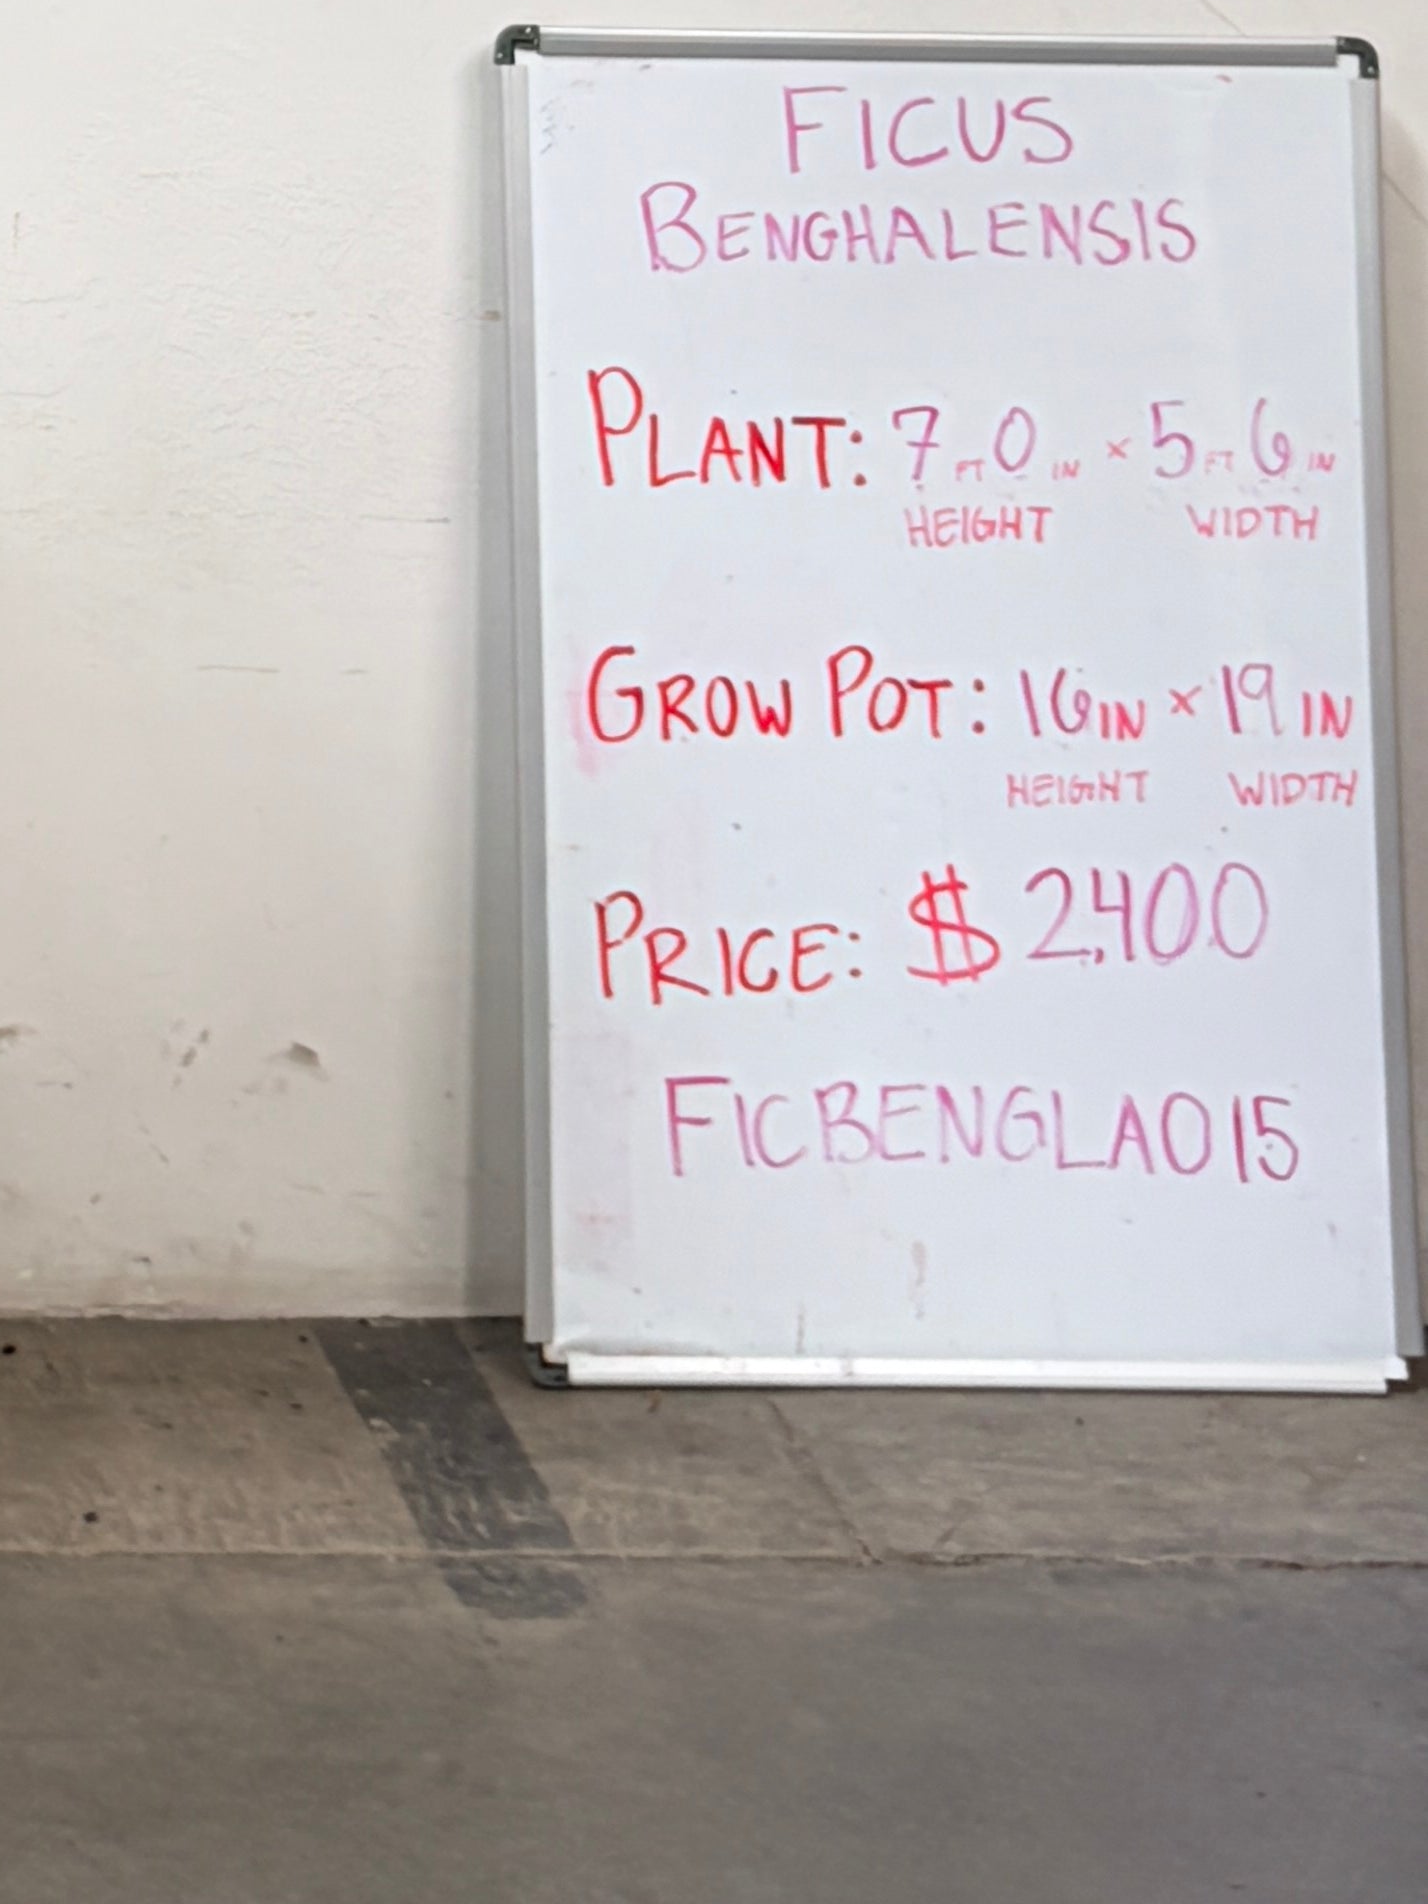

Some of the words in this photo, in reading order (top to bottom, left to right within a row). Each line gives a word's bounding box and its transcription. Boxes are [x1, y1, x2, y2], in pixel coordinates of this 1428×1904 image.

[781, 85, 1075, 174] FICUS
[638, 180, 1199, 274] BENGHALENSIS
[585, 365, 869, 491] PLANT:
[903, 504, 1054, 548] HEIGHT
[1185, 503, 1321, 542] WIDTH
[585, 644, 794, 744] GROW
[825, 644, 987, 741] POT:
[1301, 690, 1355, 741] IN
[1005, 770, 1150, 809] HEIGHT
[1227, 769, 1360, 809] WIDTH
[592, 889, 864, 1007] PRICE:
[664, 1075, 1301, 1185] FICBENGLA015
